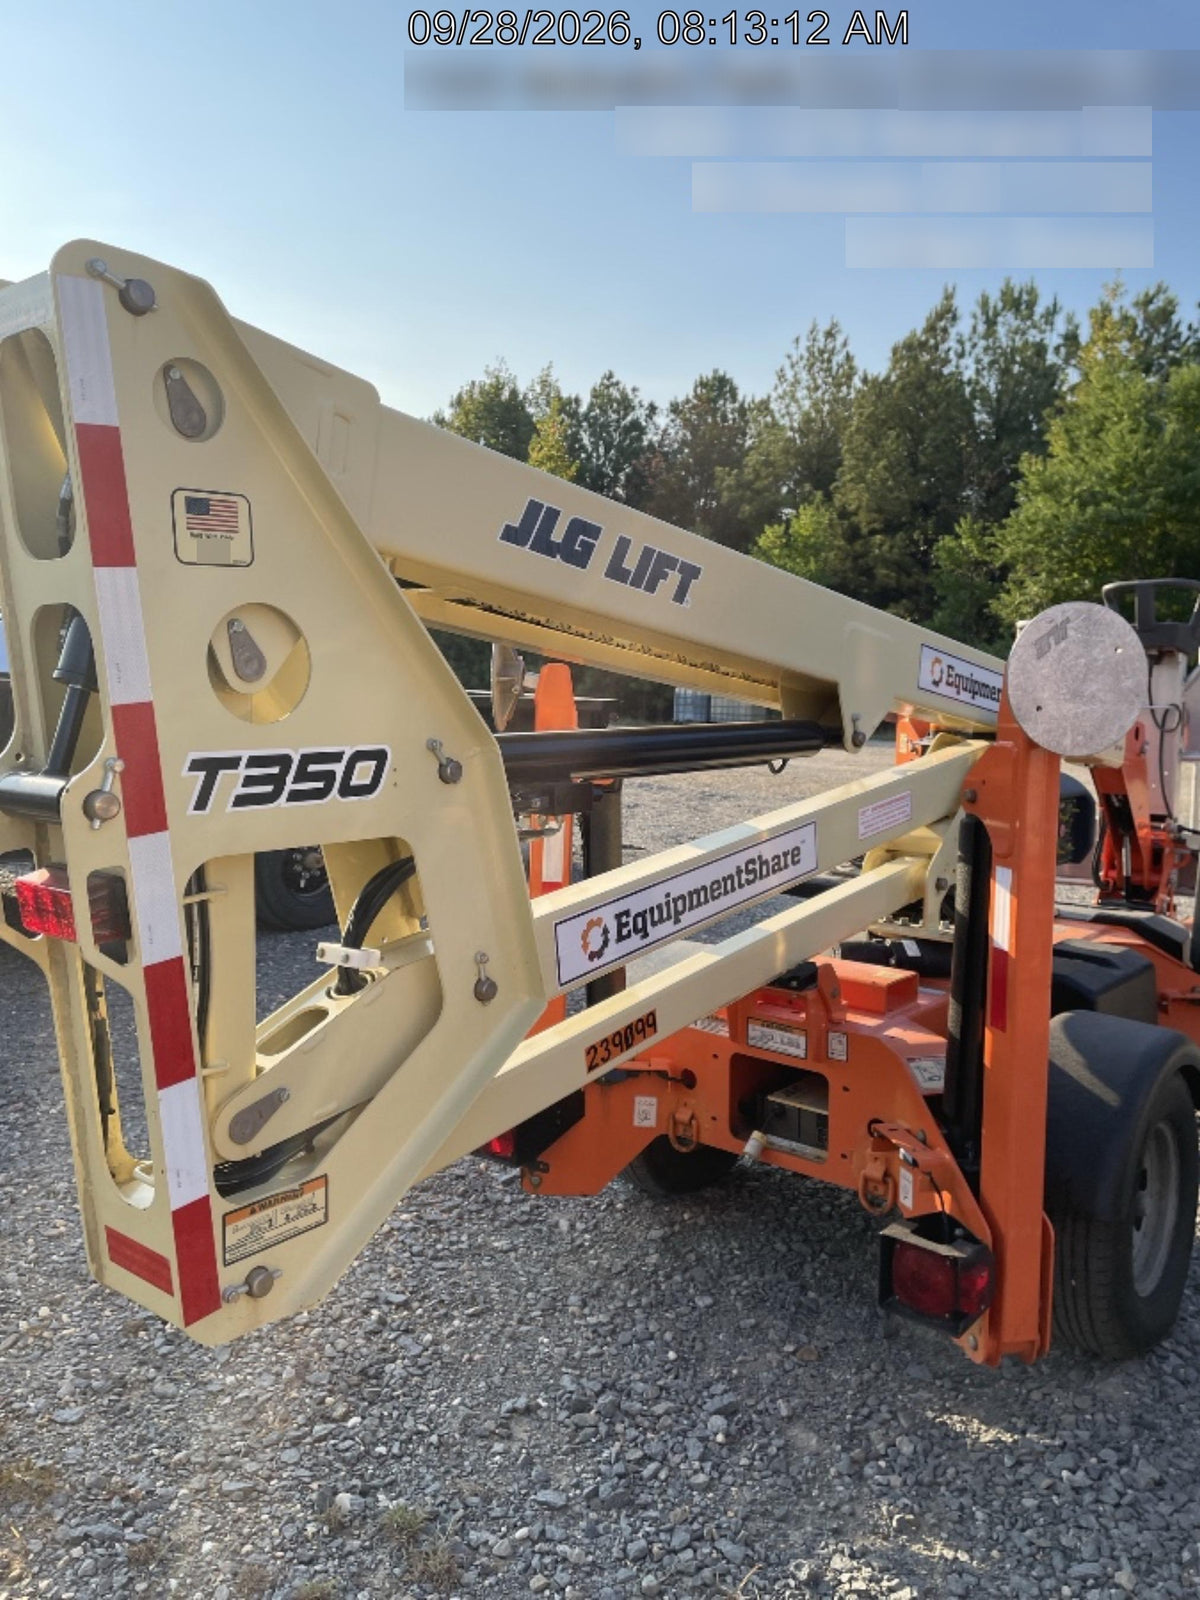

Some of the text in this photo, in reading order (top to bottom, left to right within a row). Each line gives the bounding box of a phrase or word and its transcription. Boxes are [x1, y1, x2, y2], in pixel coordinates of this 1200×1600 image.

[499, 498, 703, 606] JLG LIFT
[185, 747, 390, 813] T350
[614, 844, 801, 944] EquipmentShare
